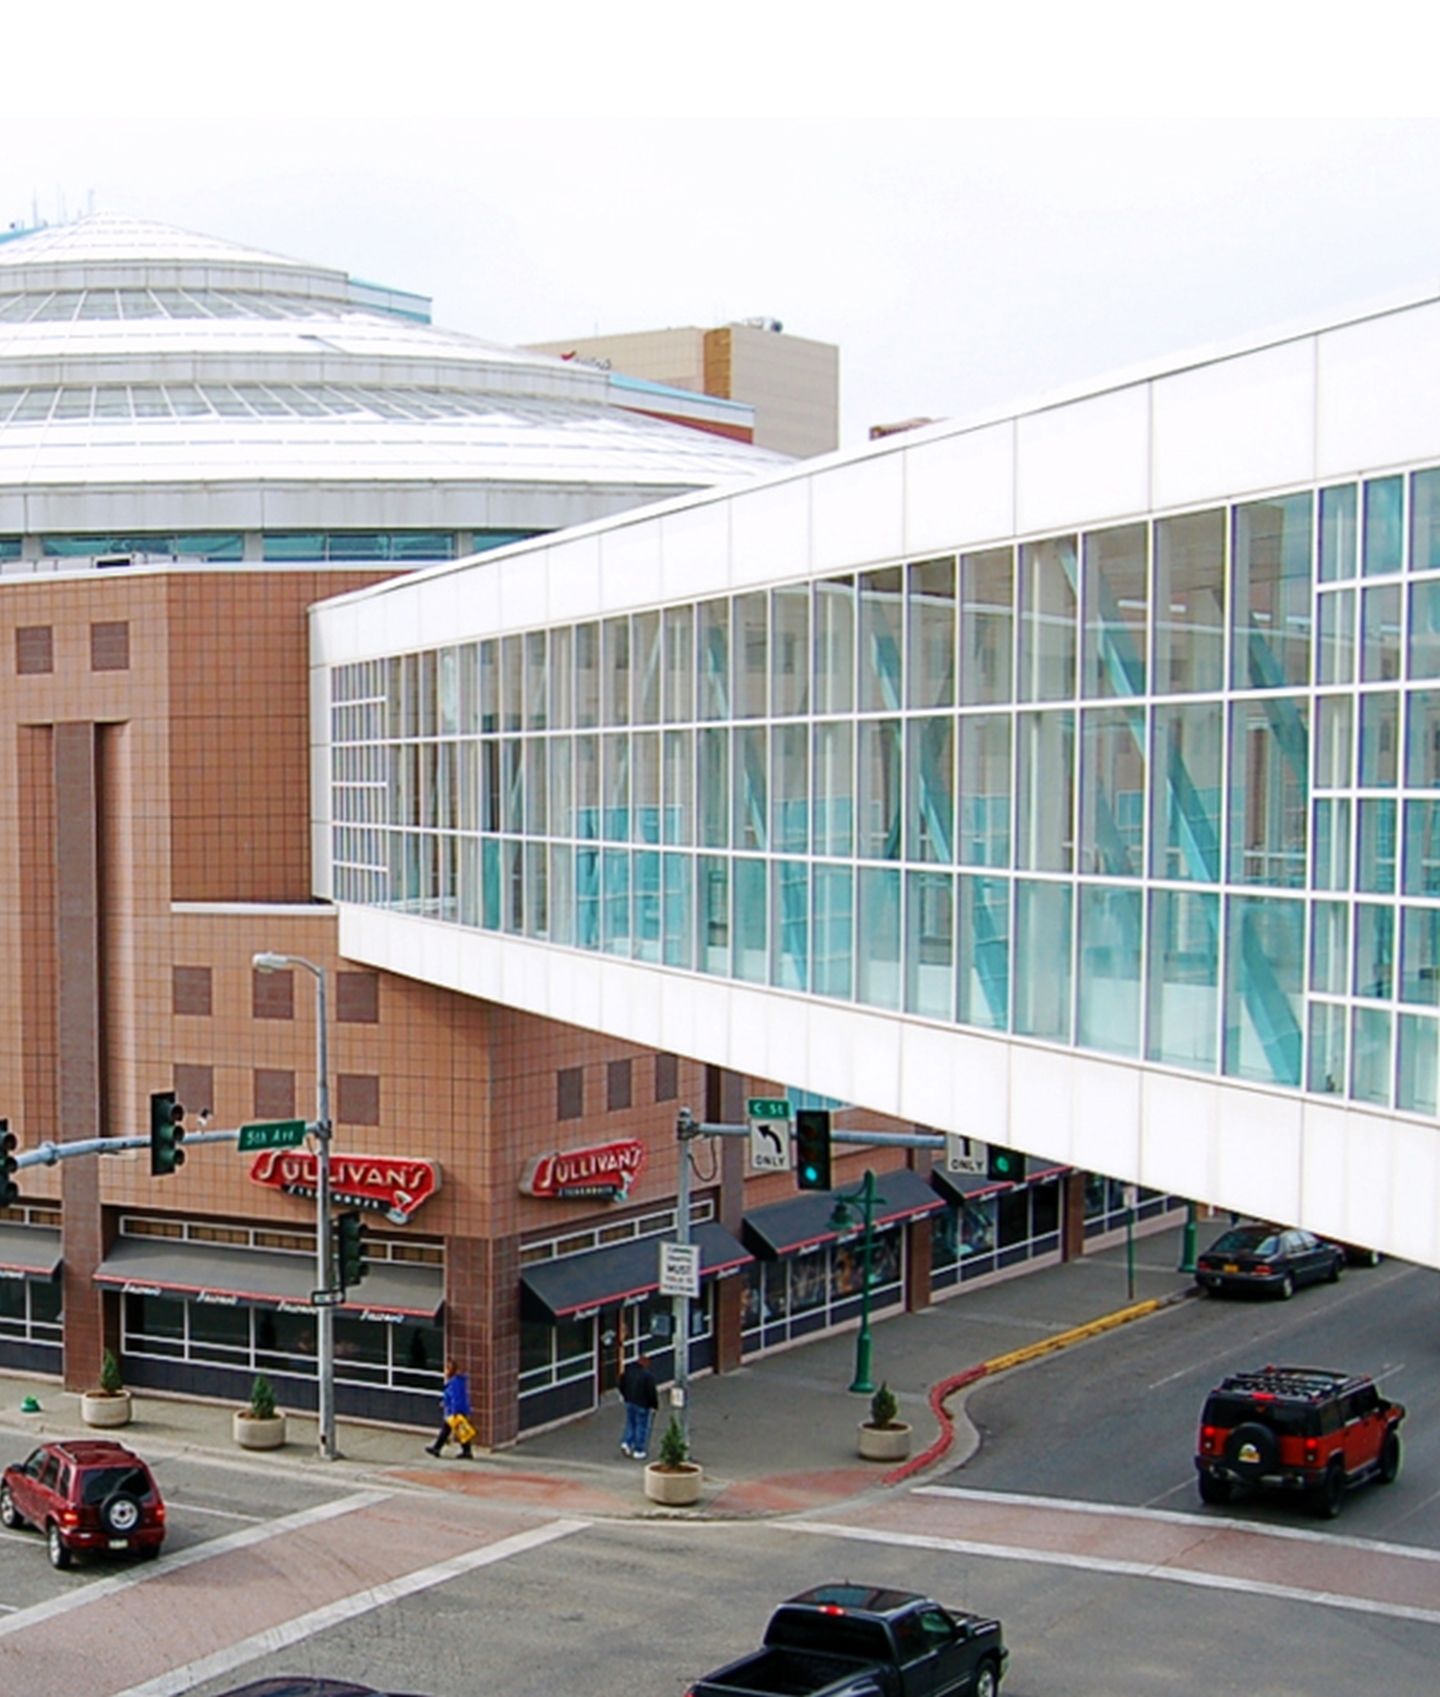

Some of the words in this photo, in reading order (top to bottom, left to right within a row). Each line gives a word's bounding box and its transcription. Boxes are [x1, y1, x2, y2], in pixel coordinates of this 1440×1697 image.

[753, 1102, 762, 1115] C
[258, 1150, 425, 1189] SULIVAN'S
[951, 1158, 984, 1172] ONLY
